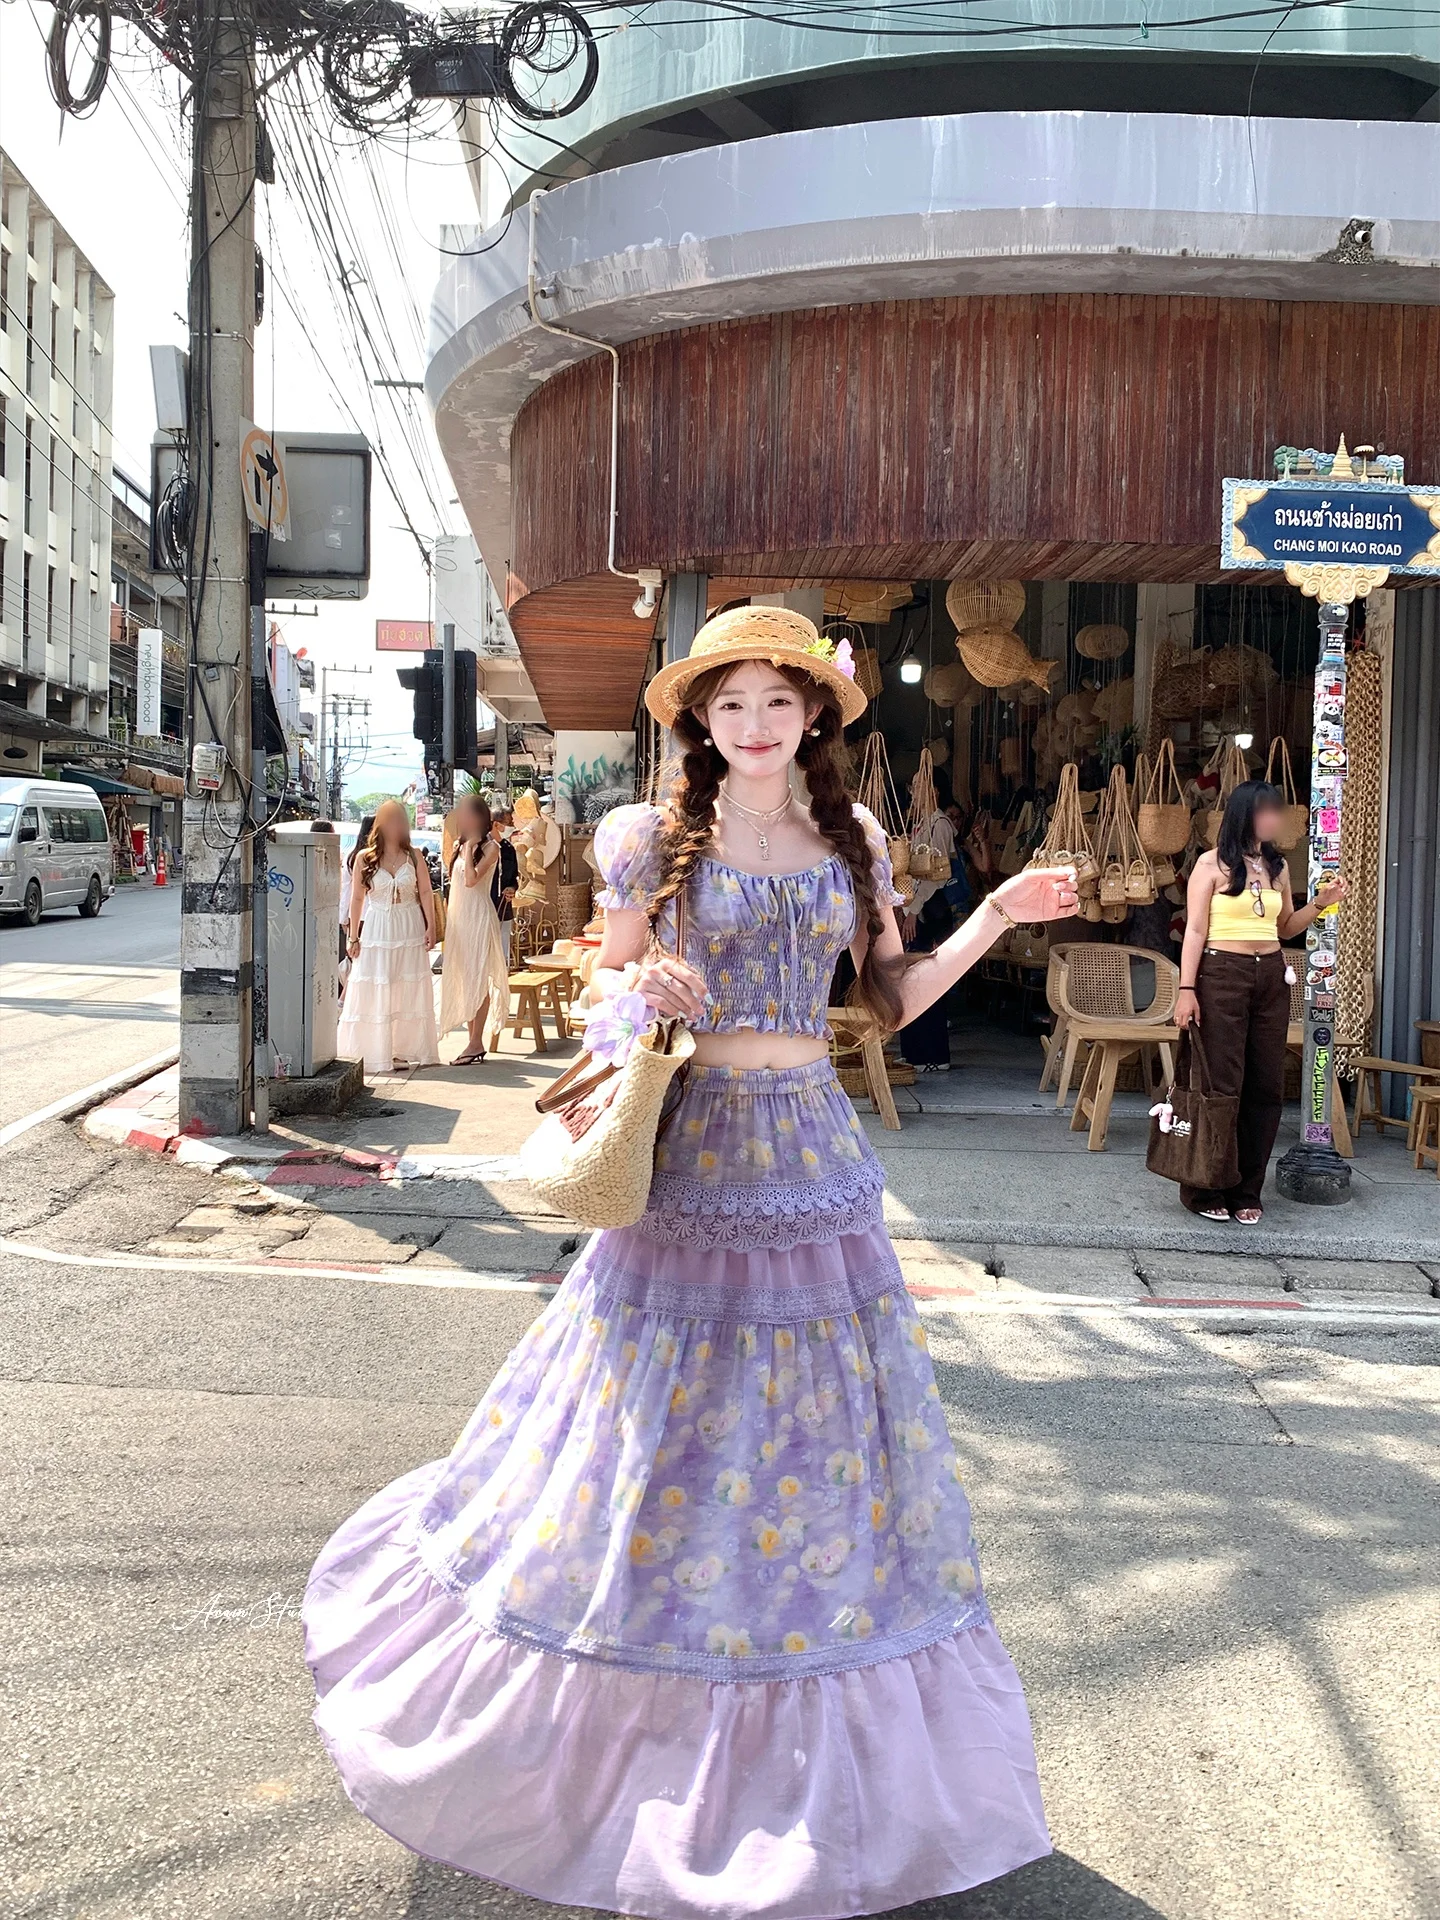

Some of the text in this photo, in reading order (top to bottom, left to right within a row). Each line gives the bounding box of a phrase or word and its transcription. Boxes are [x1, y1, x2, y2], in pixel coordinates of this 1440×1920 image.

[1274, 500, 1402, 531] ถนนช้างม่อยเก่า
[1274, 539, 1402, 556] CHANG MOI KAO ROAD
[142, 643, 155, 723] neighborhood
[1172, 1115, 1191, 1131] Lee
